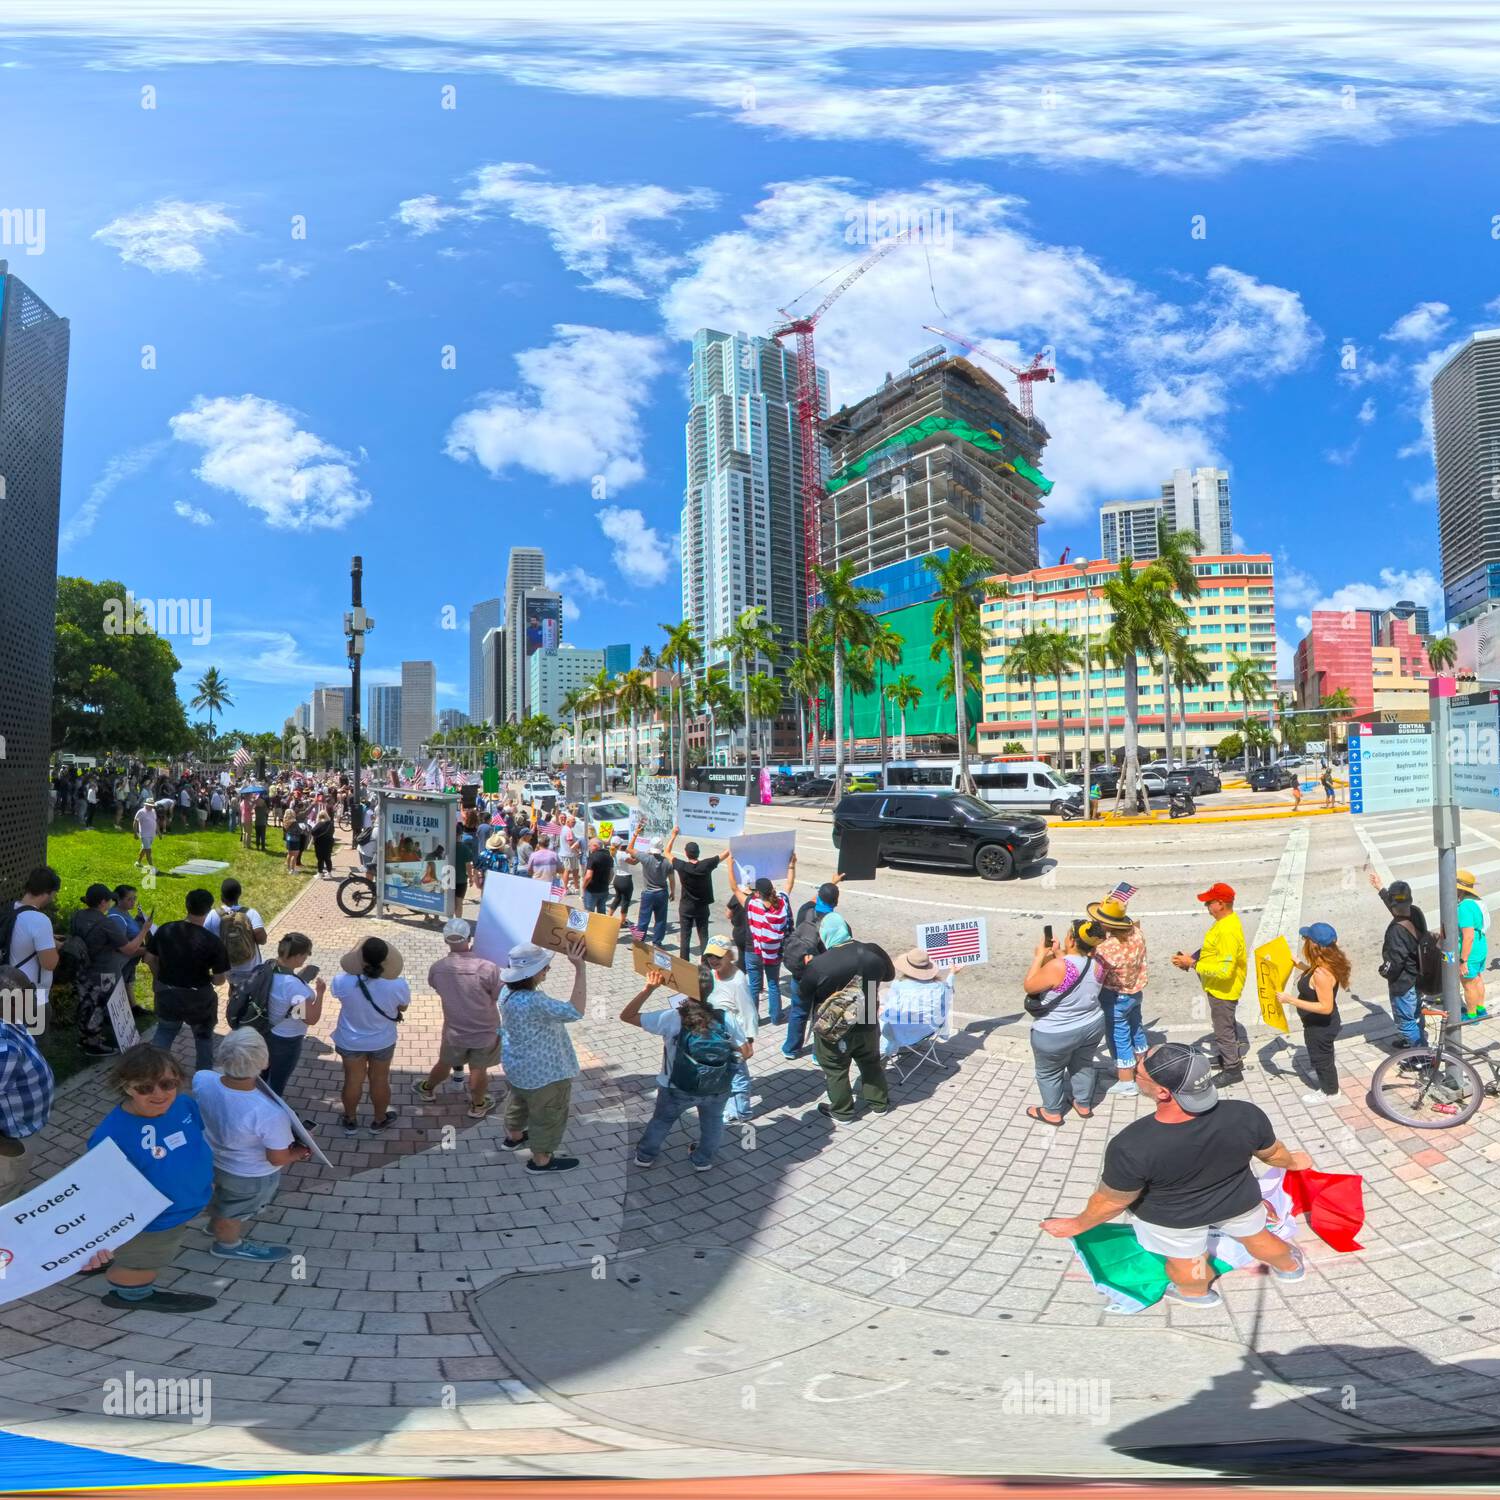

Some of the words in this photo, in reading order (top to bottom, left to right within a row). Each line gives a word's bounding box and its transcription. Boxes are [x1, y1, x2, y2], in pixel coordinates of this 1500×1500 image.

[1396, 762, 1416, 770] Bayfront
[392, 813, 414, 825] LEARN
[415, 816, 421, 826] &
[422, 816, 439, 828] EARN
[925, 920, 979, 934] PRO-AMERICA
[934, 953, 981, 967] TI-TRUMP
[14, 1182, 81, 1225] Protect
[54, 1212, 88, 1236] Our
[40, 1211, 136, 1272] Democracy
